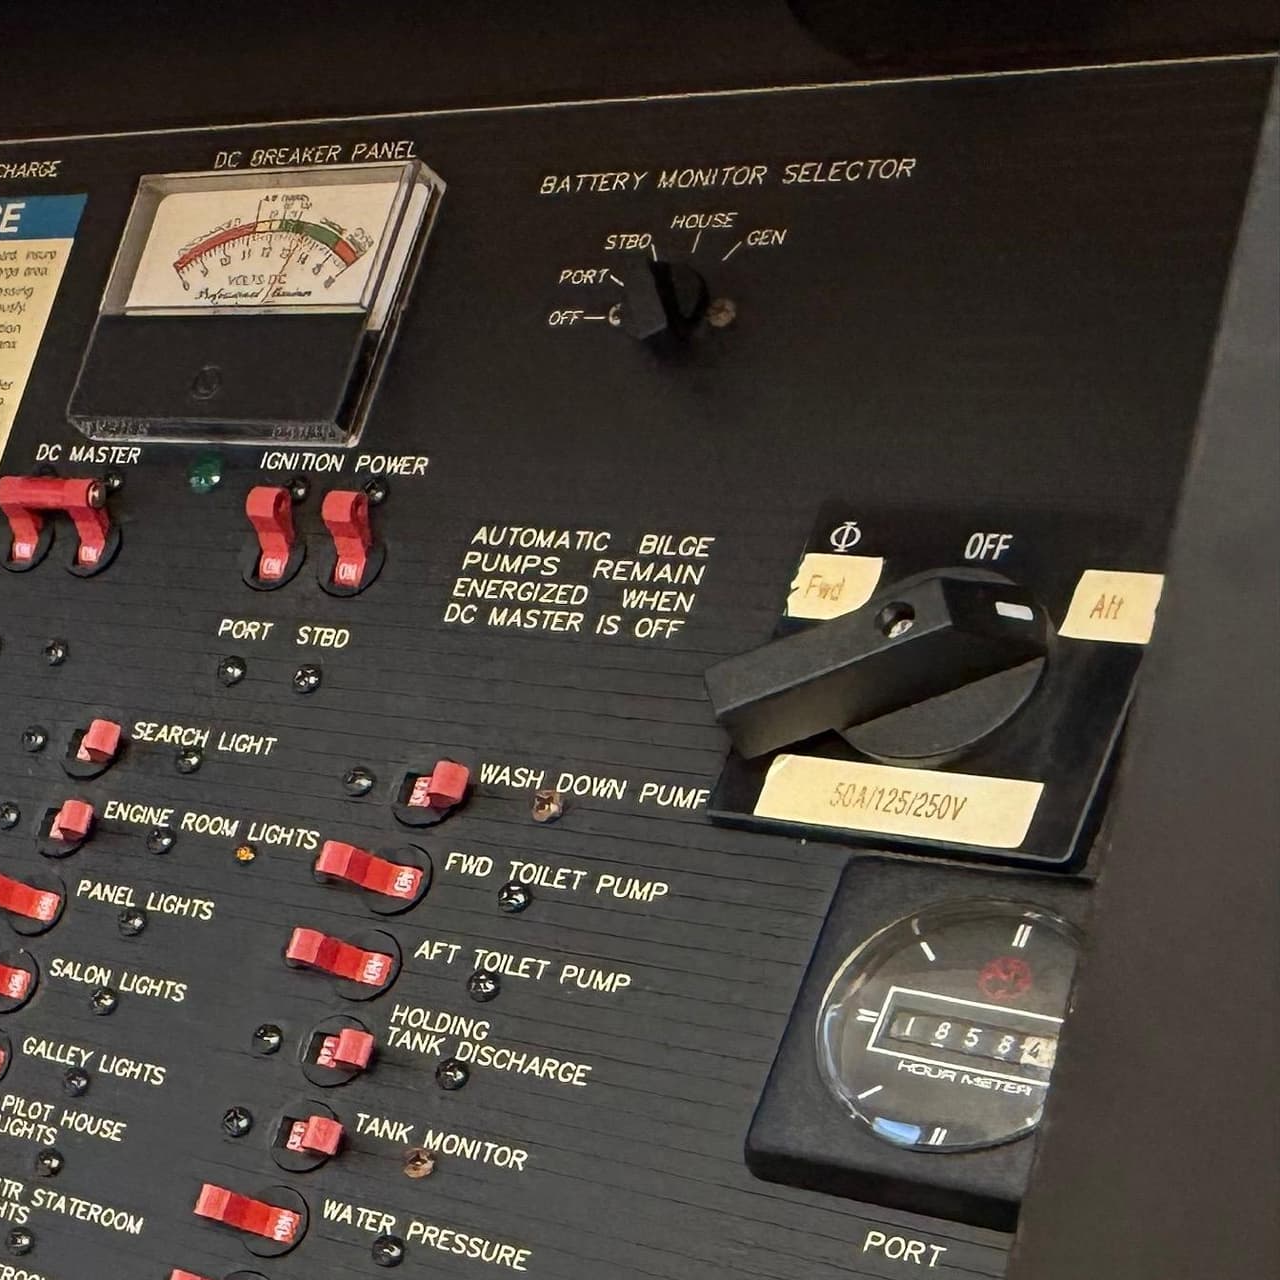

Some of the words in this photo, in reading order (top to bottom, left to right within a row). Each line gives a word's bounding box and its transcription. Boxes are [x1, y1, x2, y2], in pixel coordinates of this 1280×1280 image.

[214, 150, 242, 169] DC
[250, 144, 342, 168] BREAKER
[351, 140, 418, 160] PANEL
[540, 172, 647, 194] BATTERY
[657, 165, 768, 189] MONITOR
[781, 158, 917, 184] SELECTOR
[671, 212, 739, 229] HOUSE
[747, 229, 788, 246] GEN
[559, 269, 610, 285] PORT
[548, 311, 584, 325] OFF
[36, 444, 61, 463] DC
[69, 446, 141, 465] MASTER
[260, 452, 345, 473] IGNITION
[354, 455, 429, 476] POWER
[471, 526, 612, 552] AUTOMATIC
[638, 534, 716, 558] BILGE
[964, 532, 1015, 562] OFF
[461, 551, 561, 576] PUMPS
[592, 559, 706, 586] REMAIN
[452, 578, 589, 605] ENERGIZED
[622, 588, 696, 613] WHEN
[806, 574, 845, 602] Fwd
[217, 619, 274, 641] PORT
[296, 627, 349, 648] STBD
[444, 604, 479, 625] DC
[488, 608, 585, 634] MASTER
[595, 615, 621, 636] IS
[634, 617, 686, 640] OFF
[132, 721, 211, 748] SEARCH
[218, 731, 278, 757] LIGHT
[479, 763, 546, 790] WASH
[556, 772, 628, 800] DOWN
[828, 781, 969, 823] 50A/125/250V
[103, 800, 174, 827] ENGINE
[181, 813, 239, 838] ROOM
[247, 823, 320, 851] LIGHTS
[444, 852, 494, 877] FWD
[508, 860, 588, 891] TOILET
[595, 873, 670, 902] PUMP
[77, 879, 136, 907] PANEL
[146, 891, 215, 922] LIGHTS
[49, 958, 112, 987] SALON
[119, 971, 188, 1003] LIGHTS
[413, 940, 461, 964] AFT
[473, 949, 551, 981] TOILET
[559, 964, 631, 993] PUMP
[390, 1003, 491, 1042] HOLDING
[22, 1036, 92, 1069] GALLEY
[98, 1054, 168, 1087] LIGHTS
[387, 1026, 446, 1057] TANK
[454, 1040, 592, 1087] DISCHARGE
[0, 1094, 56, 1123] PILOT
[60, 1108, 128, 1144] HOUSE
[355, 1112, 415, 1144] TANK
[423, 1128, 529, 1172] MONITOR
[31, 1188, 145, 1235] STATEROOM
[323, 1198, 396, 1236] WATER
[406, 1220, 532, 1272] PRESSURE
[863, 1230, 947, 1268] PORT
